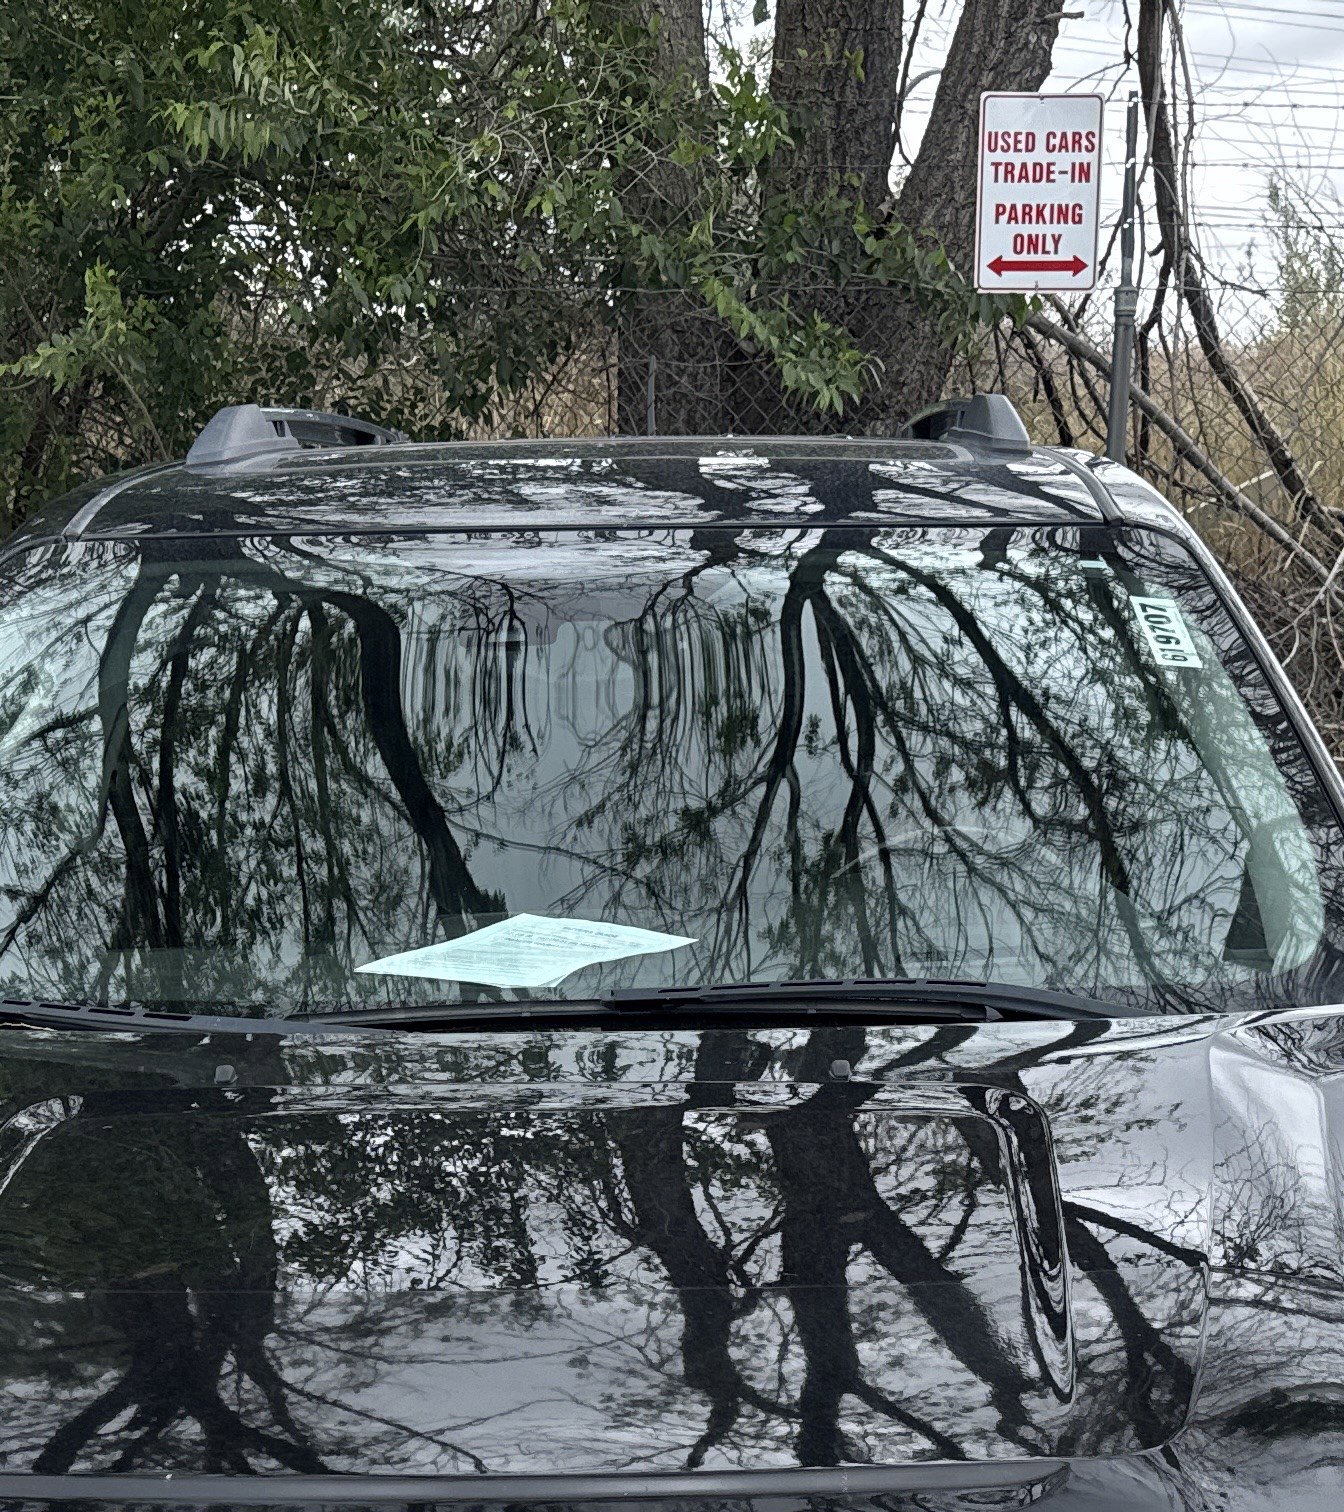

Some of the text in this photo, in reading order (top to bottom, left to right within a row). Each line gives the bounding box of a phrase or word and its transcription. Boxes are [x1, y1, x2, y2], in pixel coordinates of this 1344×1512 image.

[987, 131, 1096, 153] USED CARS
[990, 161, 1091, 184] TRADE-IN
[994, 203, 1083, 225] PARKING
[1013, 234, 1062, 255] ONLY
[1139, 603, 1188, 662] 619707
